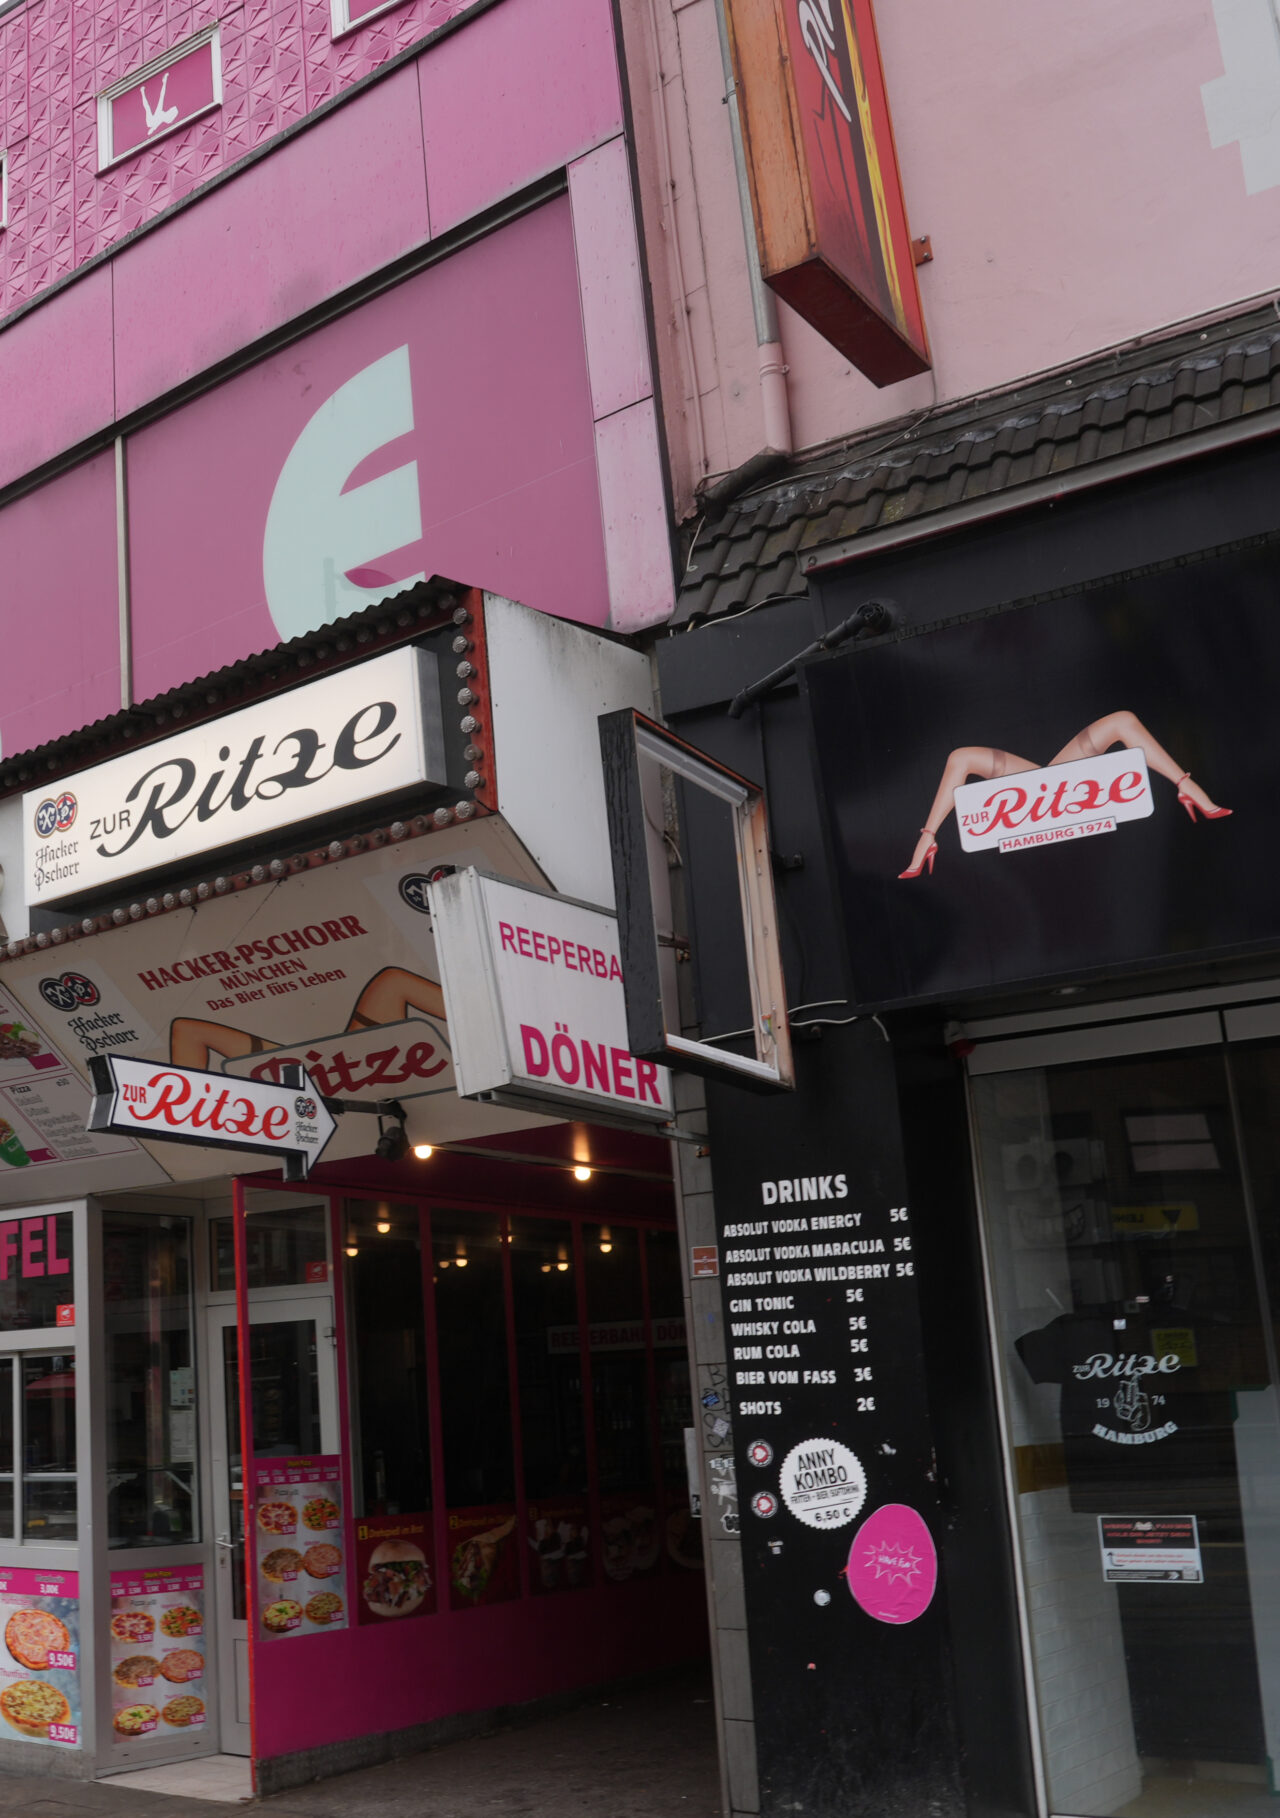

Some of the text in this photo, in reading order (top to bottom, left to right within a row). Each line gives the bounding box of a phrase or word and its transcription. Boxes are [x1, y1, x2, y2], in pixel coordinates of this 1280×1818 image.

[89, 701, 402, 857] ZUR Ritze
[962, 771, 1146, 837] ZUR Ritze
[1002, 820, 1112, 850] HAMBURG 1974
[35, 840, 79, 868] Hacker
[34, 862, 80, 892] Pschorr
[137, 915, 368, 991] HACKER-PSCHORR
[498, 921, 624, 983] REEPERBA
[219, 958, 308, 991] MÜNCHEN
[207, 969, 347, 1012] Das Bier fürs Leben
[68, 1012, 124, 1037] Hacker
[80, 1030, 139, 1055] Pschorr
[520, 1022, 662, 1105] DÖNER
[122, 1072, 290, 1140] ZUR Ritze
[761, 1174, 849, 1205] DRINKS
[724, 1207, 908, 1238] ABSOLUT VODKA ENERGY 5€
[725, 1237, 912, 1263] ABSOLUT VODKA MARACUJA 5€
[727, 1262, 915, 1287] ABSOLUT VODKA WILDBERRY 5€
[730, 1288, 864, 1313] GIN TONIC 5€
[731, 1316, 867, 1337] WHISKY COLA 5€
[734, 1338, 868, 1360] RUM COLA 5€
[736, 1367, 872, 1385] BIER VOM FASS 3€
[1074, 1353, 1182, 1380] Ritze
[740, 1397, 875, 1415] SHOTS 2€
[1096, 1395, 1166, 1408] 19 74
[1091, 1420, 1179, 1445] HAMBURG
[798, 1448, 834, 1471] ANNY
[794, 1465, 848, 1490] KOMBO
[815, 1509, 840, 1523] 6,50
[49, 1652, 75, 1668] 9,50€
[50, 1725, 75, 1741] 9,50€
